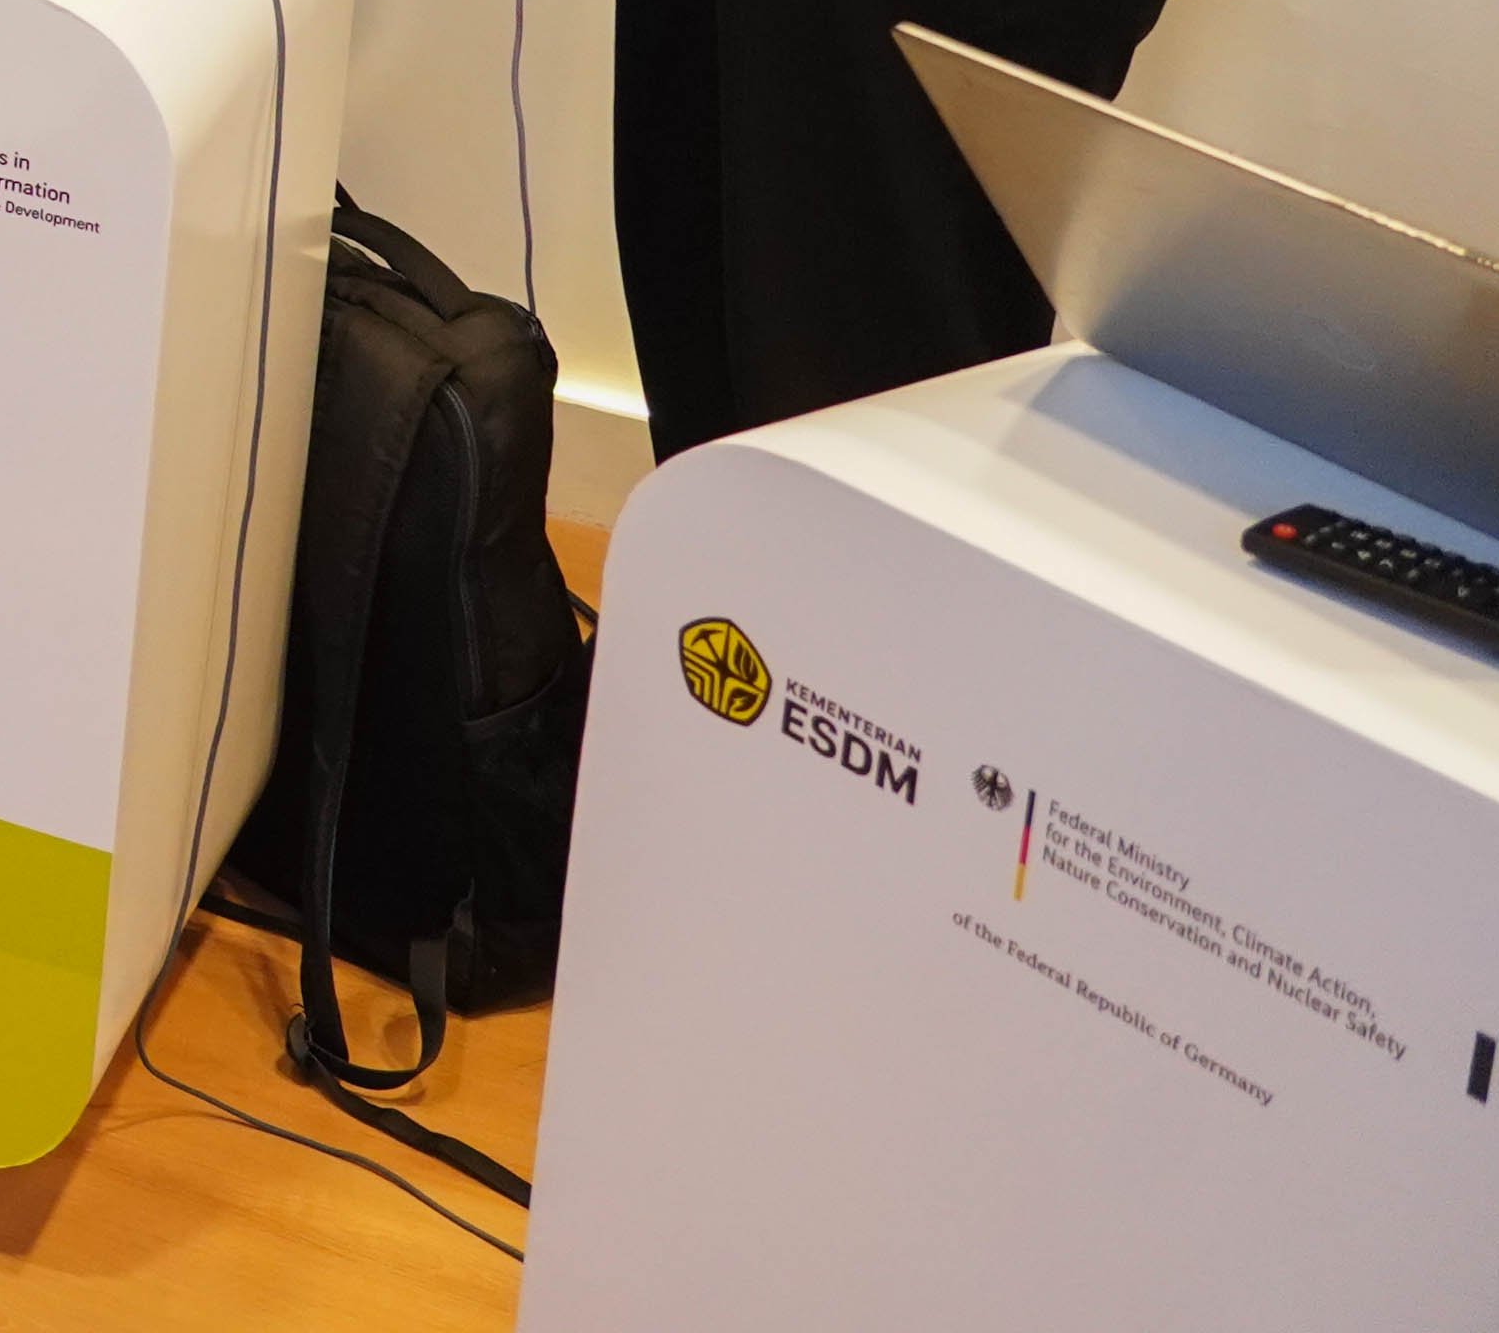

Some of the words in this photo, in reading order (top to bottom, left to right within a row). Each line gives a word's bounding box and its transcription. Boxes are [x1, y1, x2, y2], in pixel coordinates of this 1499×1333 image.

[14, 151, 29, 170] in
[5, 200, 99, 233] Development
[782, 701, 917, 805] ESDM
[786, 678, 920, 763] KEMENTERIAN
[1049, 799, 1112, 849] Federal
[1117, 836, 1189, 890] Ministry
[1042, 847, 1100, 889] Nature
[1106, 881, 1221, 957] Conservation
[1227, 951, 1261, 978] and
[1267, 967, 1340, 1020] Nuclear
[1346, 1011, 1406, 1058] Safety
[1046, 822, 1070, 847] for
[1074, 840, 1102, 867] the
[1108, 856, 1225, 937] Environment,
[1232, 924, 1302, 977] Climate
[1308, 967, 1374, 1018] Action,
[952, 913, 971, 929] of
[975, 923, 1002, 948] the
[1007, 940, 1070, 988] Federal
[1076, 980, 1154, 1037] Republic
[1160, 1032, 1180, 1050] of
[1184, 1043, 1272, 1105] Germany
